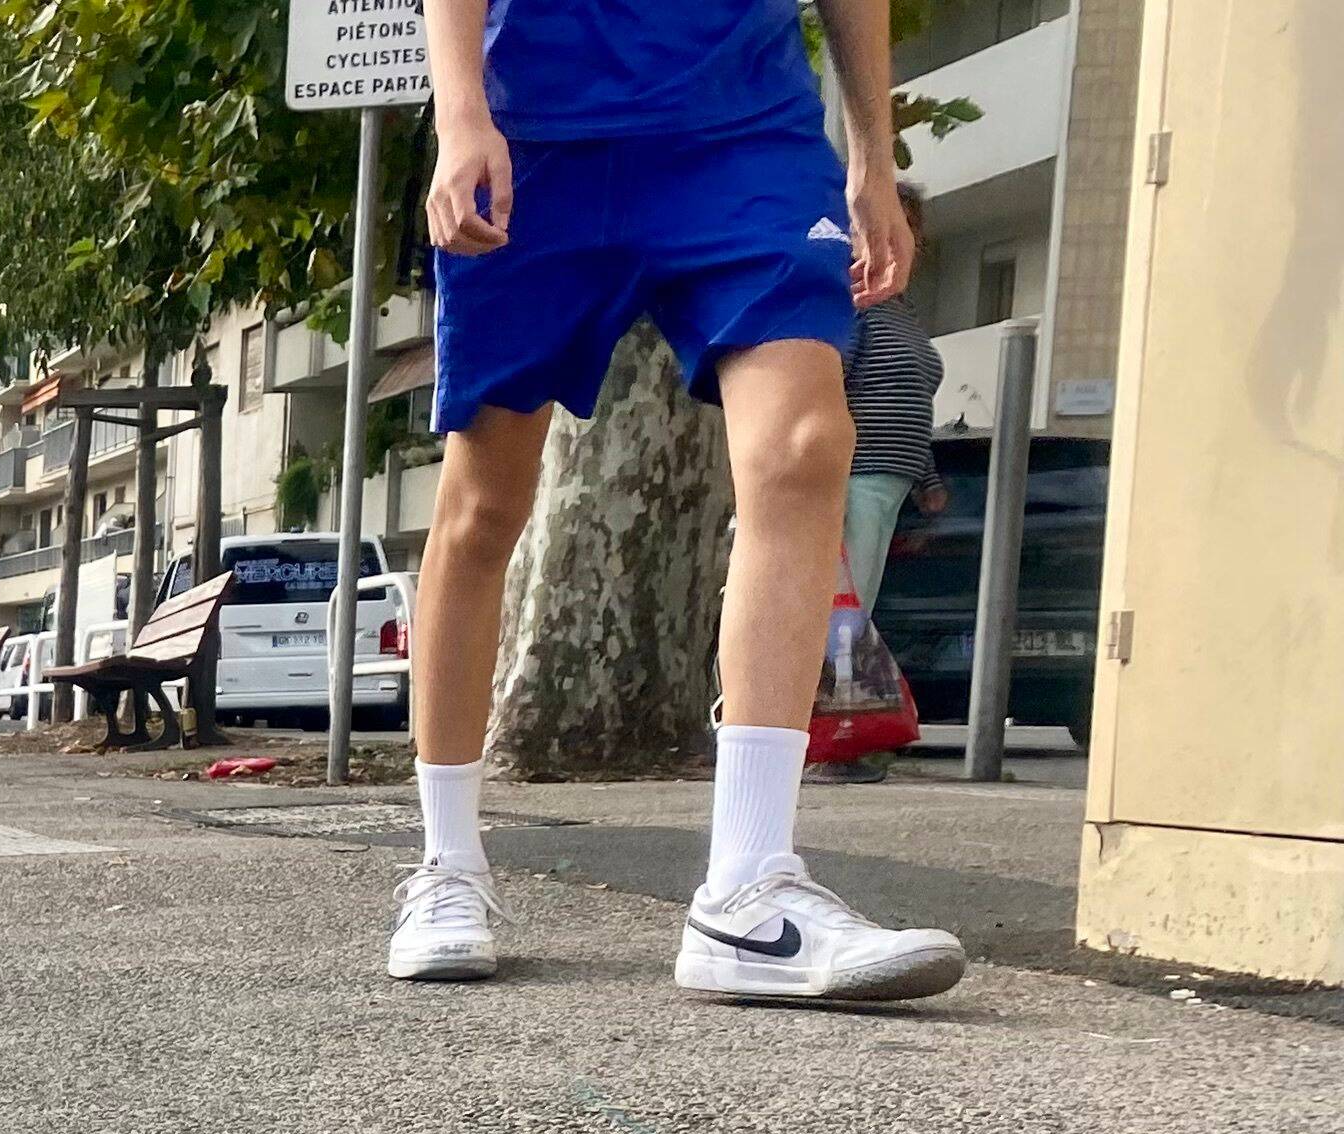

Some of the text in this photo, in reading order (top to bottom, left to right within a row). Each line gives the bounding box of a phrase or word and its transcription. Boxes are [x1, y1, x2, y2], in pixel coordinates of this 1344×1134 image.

[337, 21, 417, 41] PIÉTONS
[326, 48, 426, 69] CYCLISTES
[295, 75, 431, 99] ESPACE PARTA
